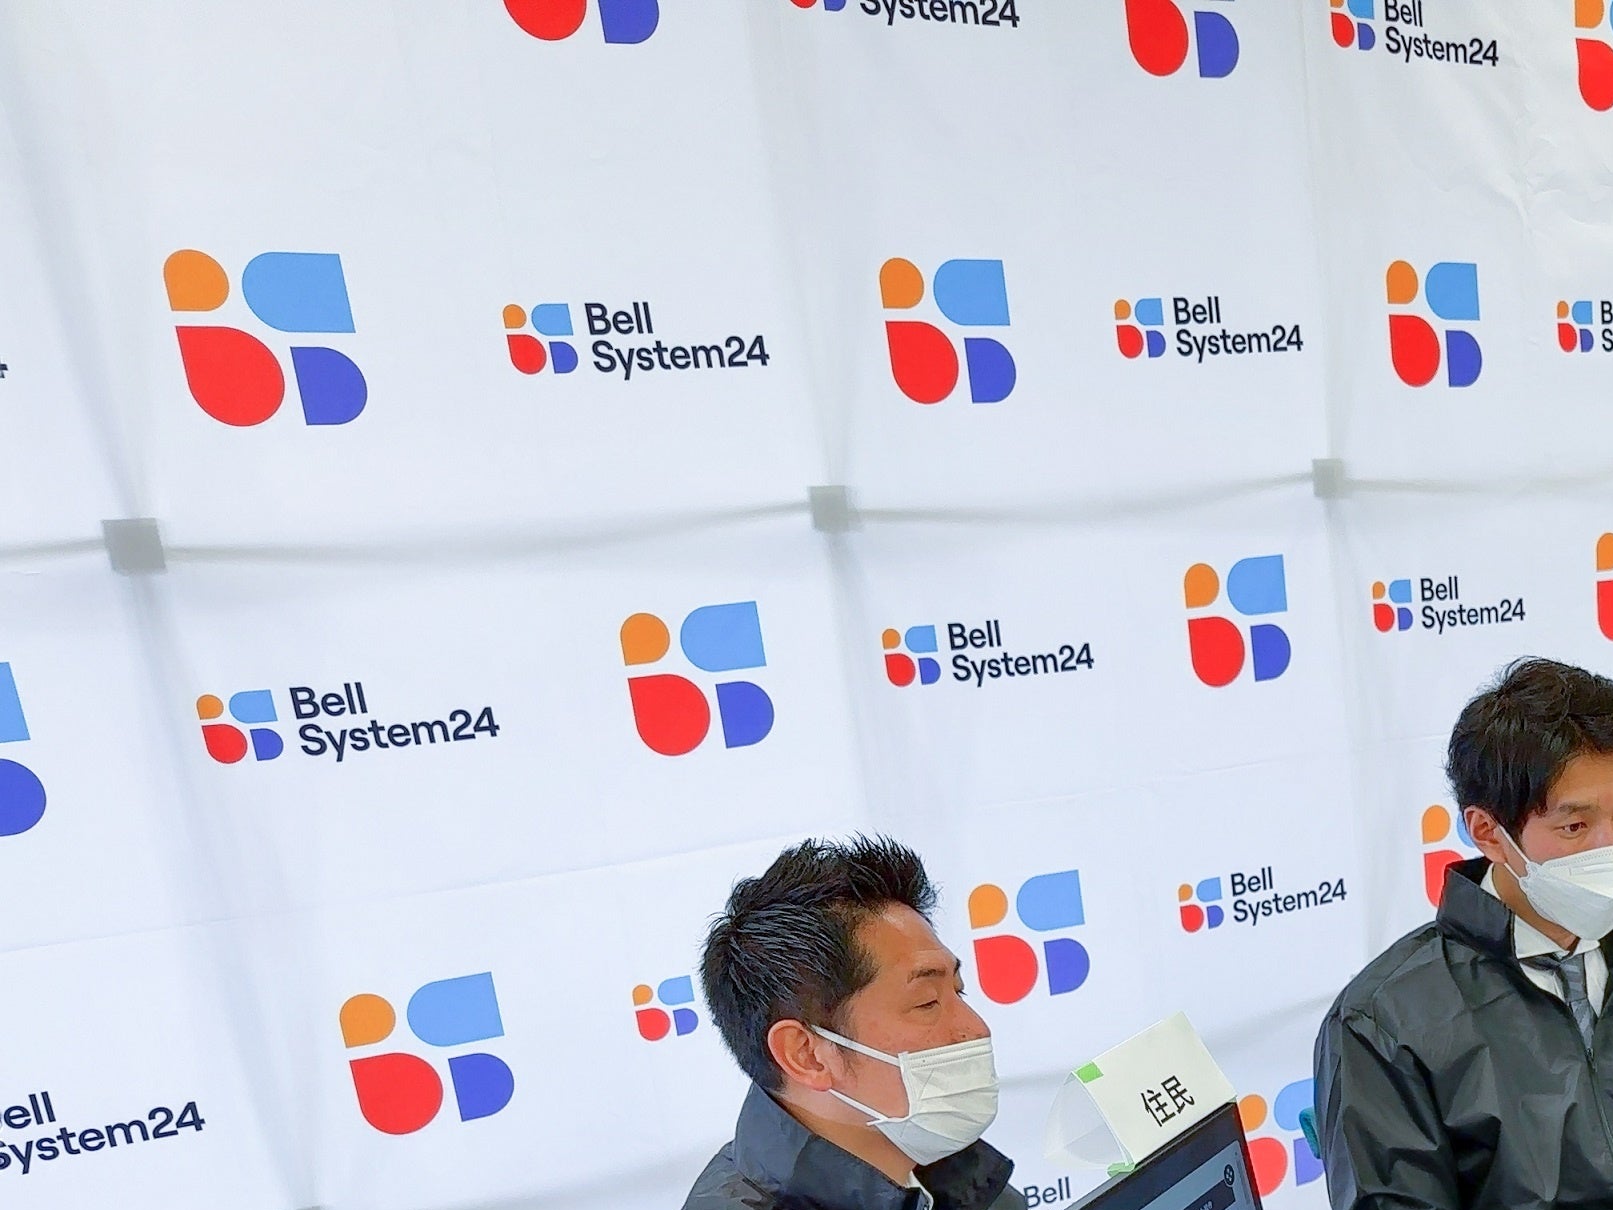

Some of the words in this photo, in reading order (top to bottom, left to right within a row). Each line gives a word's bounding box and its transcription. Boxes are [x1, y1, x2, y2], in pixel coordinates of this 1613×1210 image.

[1385, 0, 1423, 27] Bell
[1385, 26, 1499, 67] System24
[585, 302, 654, 335] Bell
[1173, 296, 1220, 325] Bell
[592, 336, 770, 380] System24
[1176, 325, 1304, 363] System24
[1420, 576, 1459, 602] Bell
[948, 620, 1002, 651] Bell
[1422, 599, 1526, 634] System24
[952, 643, 1094, 687] System24
[290, 682, 368, 720] Bell
[299, 707, 500, 762] System24
[1231, 867, 1273, 896] Bell
[1233, 879, 1347, 925] System24
[0, 1091, 57, 1130] ell
[1140, 1075, 1196, 1128] 住民
[1024, 1177, 1071, 1209] Bell
